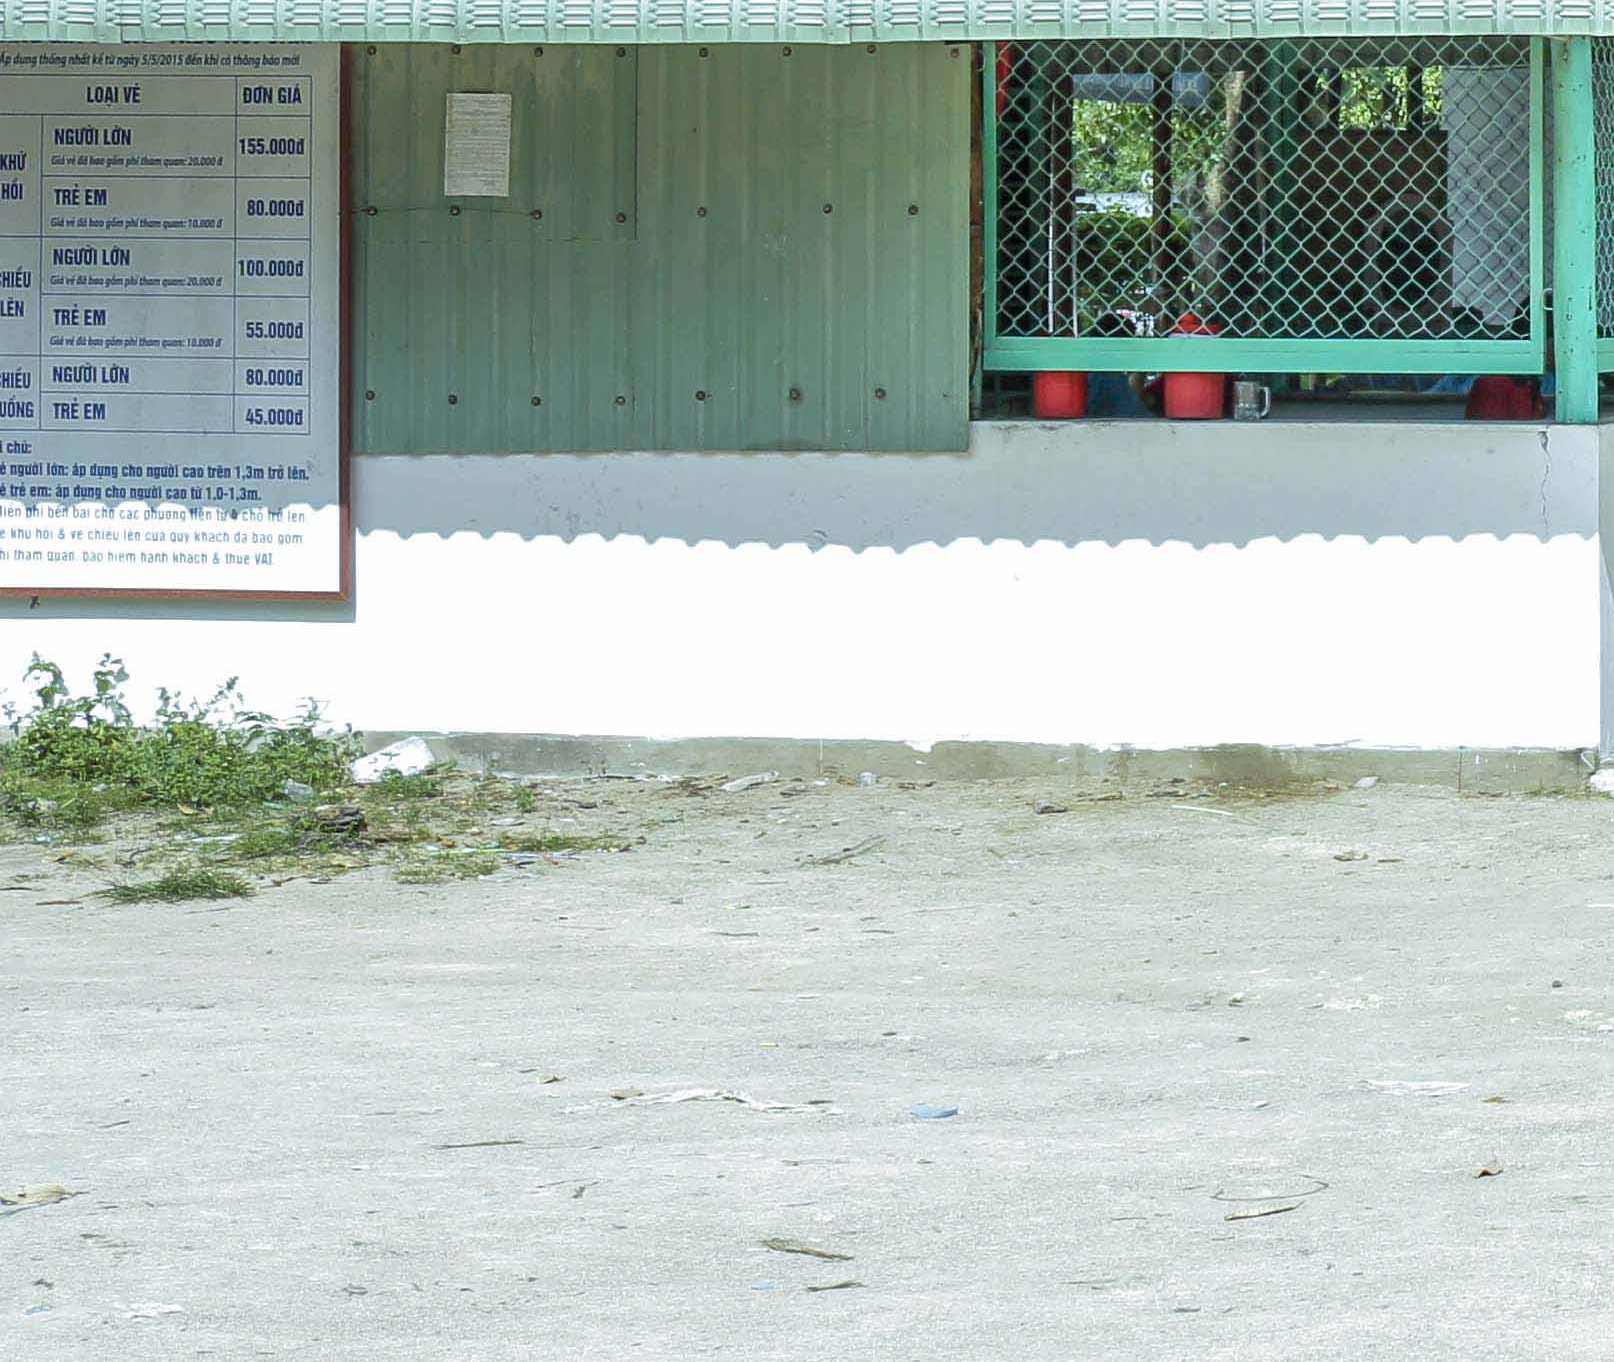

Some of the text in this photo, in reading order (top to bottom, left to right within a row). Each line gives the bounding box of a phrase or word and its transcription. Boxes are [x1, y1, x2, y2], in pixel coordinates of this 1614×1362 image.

[141, 54, 184, 65] 5/5/2015
[87, 86, 118, 107] LOẠI
[243, 83, 302, 104] ĐƠN GIÁ
[54, 125, 131, 146] NGƯỜI LỚN
[239, 138, 304, 155] 155.000đ
[54, 183, 107, 206] TRẺ EM
[247, 200, 304, 216] 80.000đ
[53, 244, 130, 266] NGƯỜI LỚN
[238, 259, 304, 276] 100.000đ
[0, 297, 24, 317] LÊN
[53, 303, 106, 326] TRẺ EM
[246, 322, 303, 338] 55.000đ
[53, 362, 130, 384] NGƯỜI LỚN
[246, 369, 303, 386] 80.000đ
[0, 395, 34, 418] UỐNG
[53, 397, 106, 420] TRẺ EM
[245, 409, 303, 426] 45.000đ
[0, 461, 6, 475] é
[122, 464, 143, 477] cho
[183, 467, 204, 478] cao
[0, 481, 6, 496] é
[105, 485, 126, 498] cho
[166, 488, 187, 499] cao
